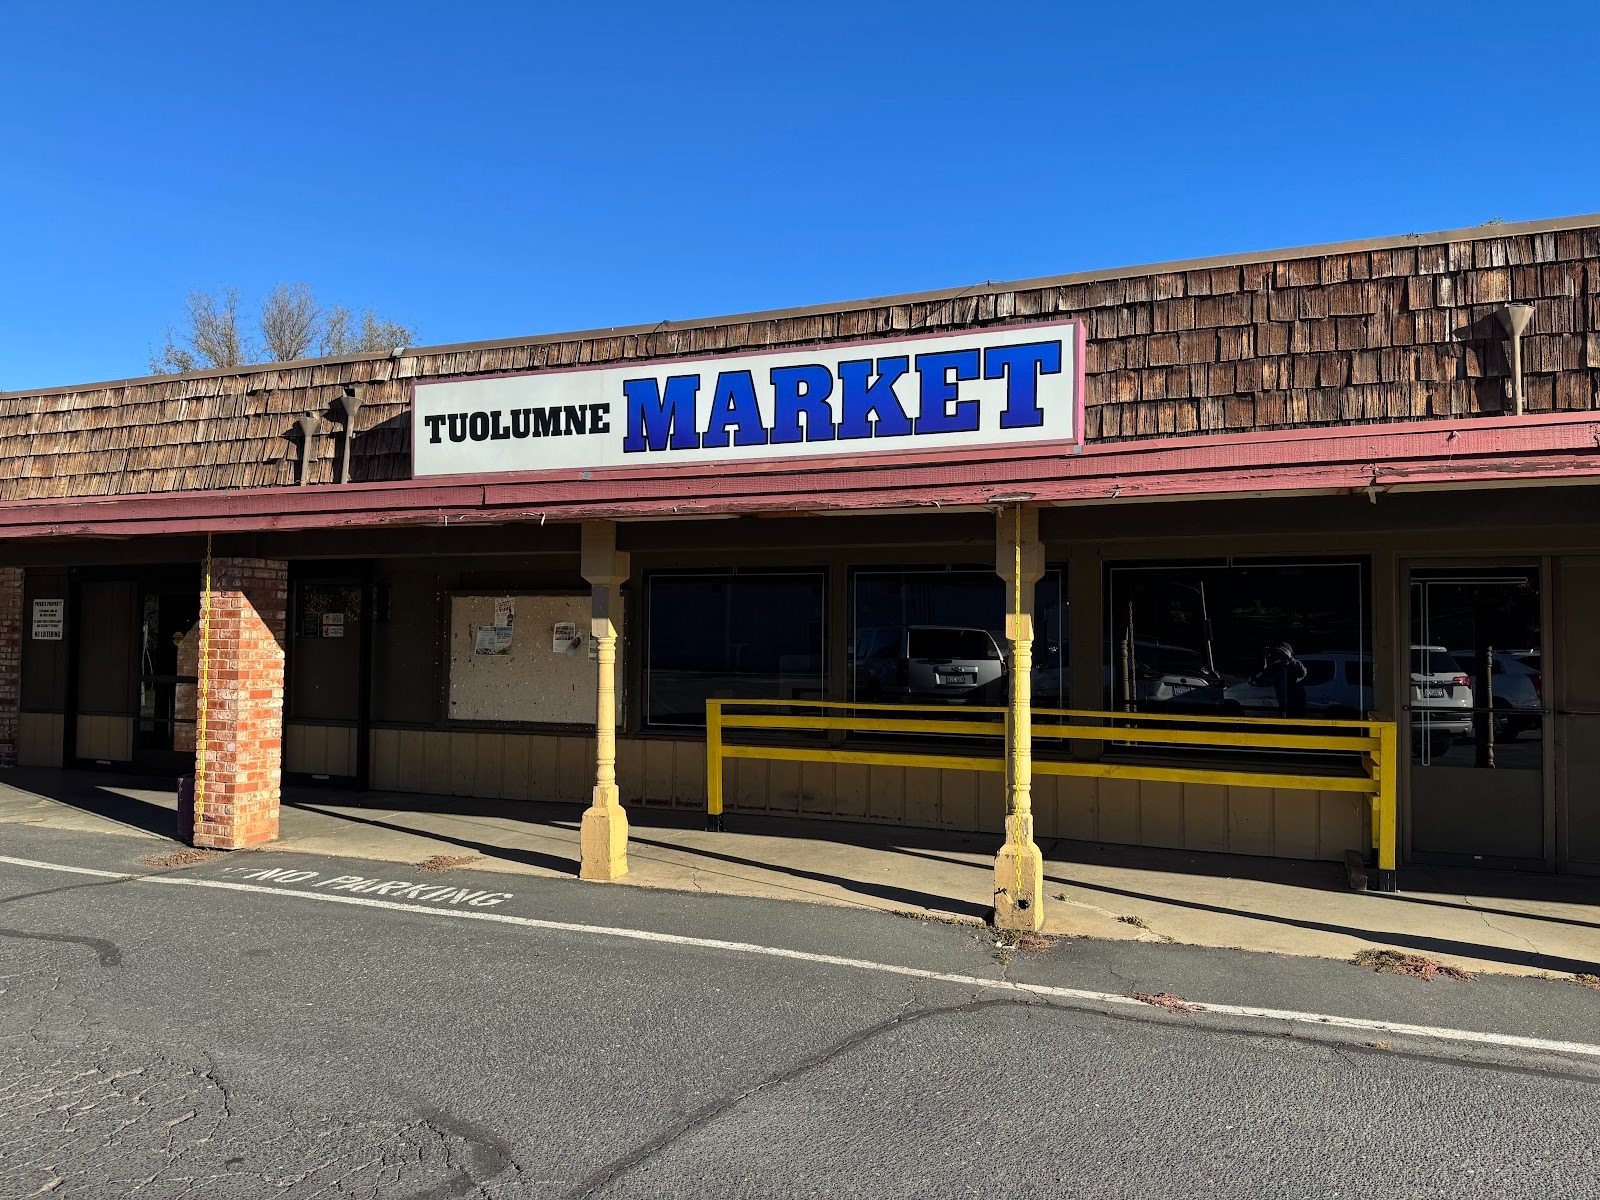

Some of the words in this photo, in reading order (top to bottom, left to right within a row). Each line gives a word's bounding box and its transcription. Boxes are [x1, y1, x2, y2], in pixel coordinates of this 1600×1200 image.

[424, 402, 610, 444] TUOLUMNE
[623, 340, 1062, 453] MARKET
[244, 867, 319, 883] NO
[311, 875, 514, 906] PARKING
